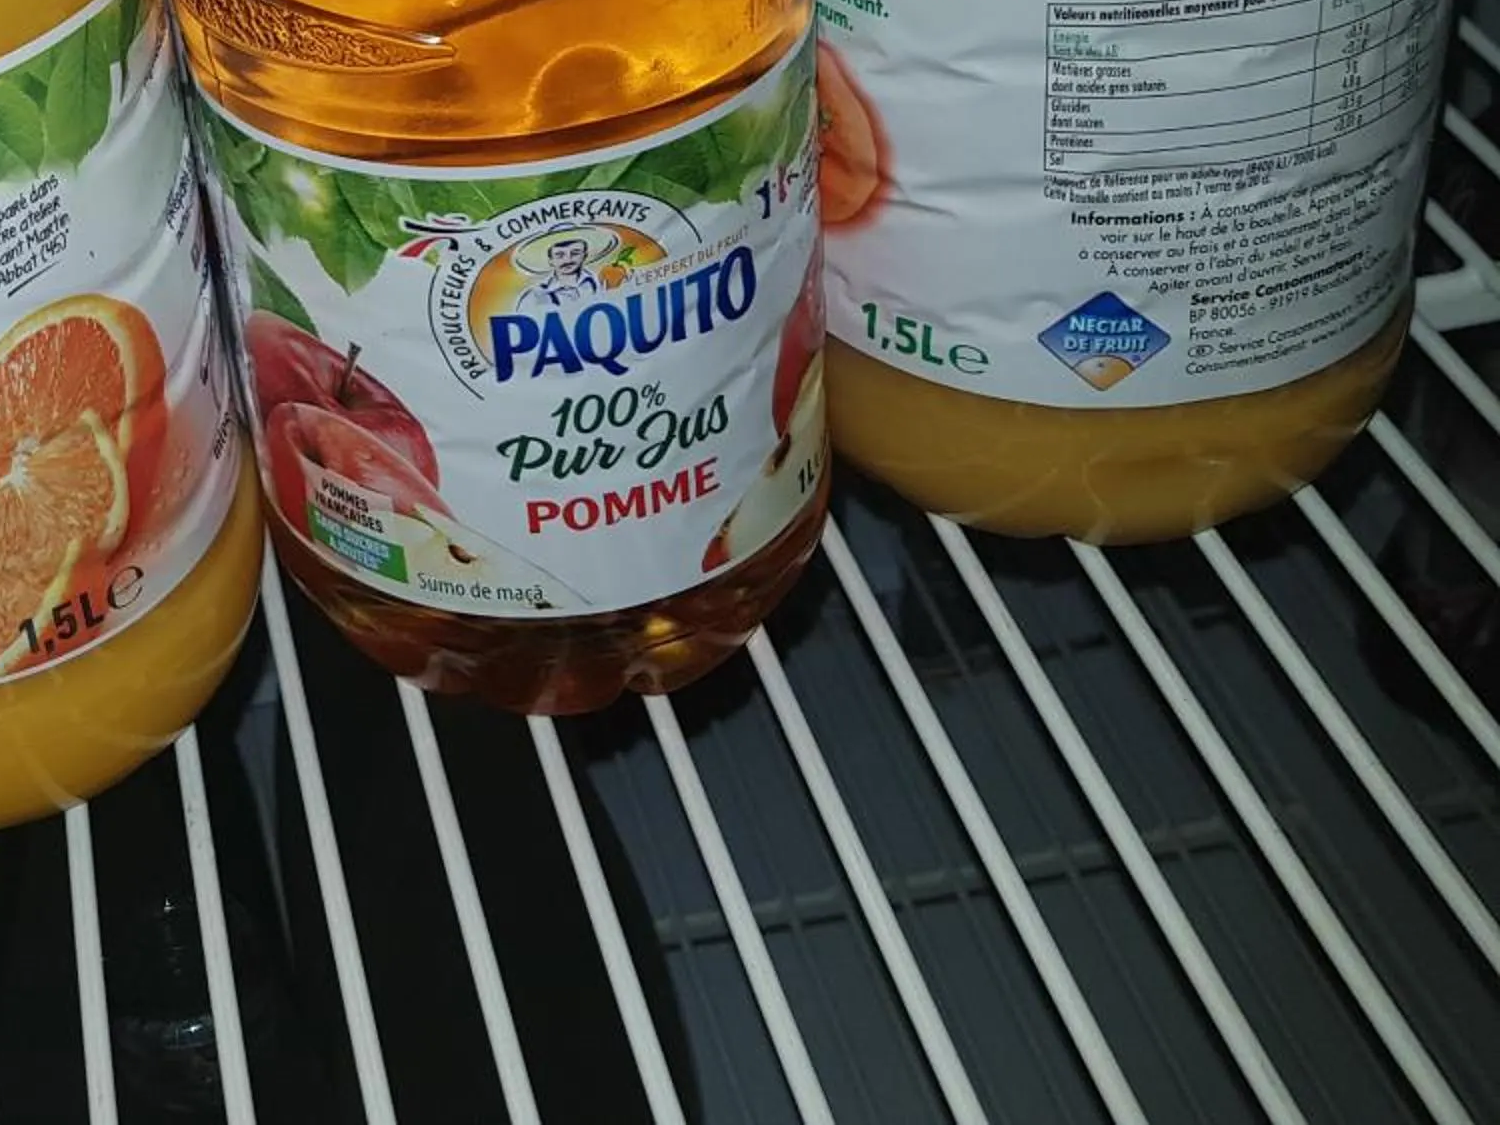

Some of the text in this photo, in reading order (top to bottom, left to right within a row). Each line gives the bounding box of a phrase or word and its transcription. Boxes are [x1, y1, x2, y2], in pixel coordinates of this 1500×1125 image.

[1053, 6, 1096, 21] Valeurs
[30, 174, 59, 204] dans
[496, 199, 651, 241] COMMERÇANTS
[1070, 210, 1185, 226] Informations
[1100, 231, 1128, 244] voir
[1133, 232, 1154, 243] sur
[1159, 226, 1171, 242] le
[1175, 226, 1207, 241] haut
[1210, 221, 1228, 236] de
[1233, 218, 1245, 232] la
[1093, 249, 1161, 260] conserver
[1166, 246, 1185, 258] au
[1189, 240, 1219, 256] frais
[1223, 238, 1236, 251] et
[1123, 264, 1191, 277] conserver
[1248, 248, 1266, 264] du
[635, 253, 694, 286] L'EXPERT
[697, 244, 715, 262] DU
[1190, 289, 1250, 306] Service
[1255, 250, 1364, 298] Consommateurs
[1149, 280, 1190, 294] Agiter
[1195, 273, 1232, 288] avant
[440, 255, 487, 380] PRODUCTEURS
[489, 245, 757, 383] PAQUITO
[1068, 315, 1145, 335] NECTAR
[1189, 309, 1207, 324] BP
[1210, 302, 1257, 320] 80056
[1063, 334, 1150, 353] DE FRUIT
[1218, 337, 1265, 355] Service
[551, 380, 667, 438] 100%
[496, 394, 730, 483] Pur Jus
[525, 456, 721, 535] POMME
[417, 571, 465, 597] Sumo
[470, 581, 492, 600] de
